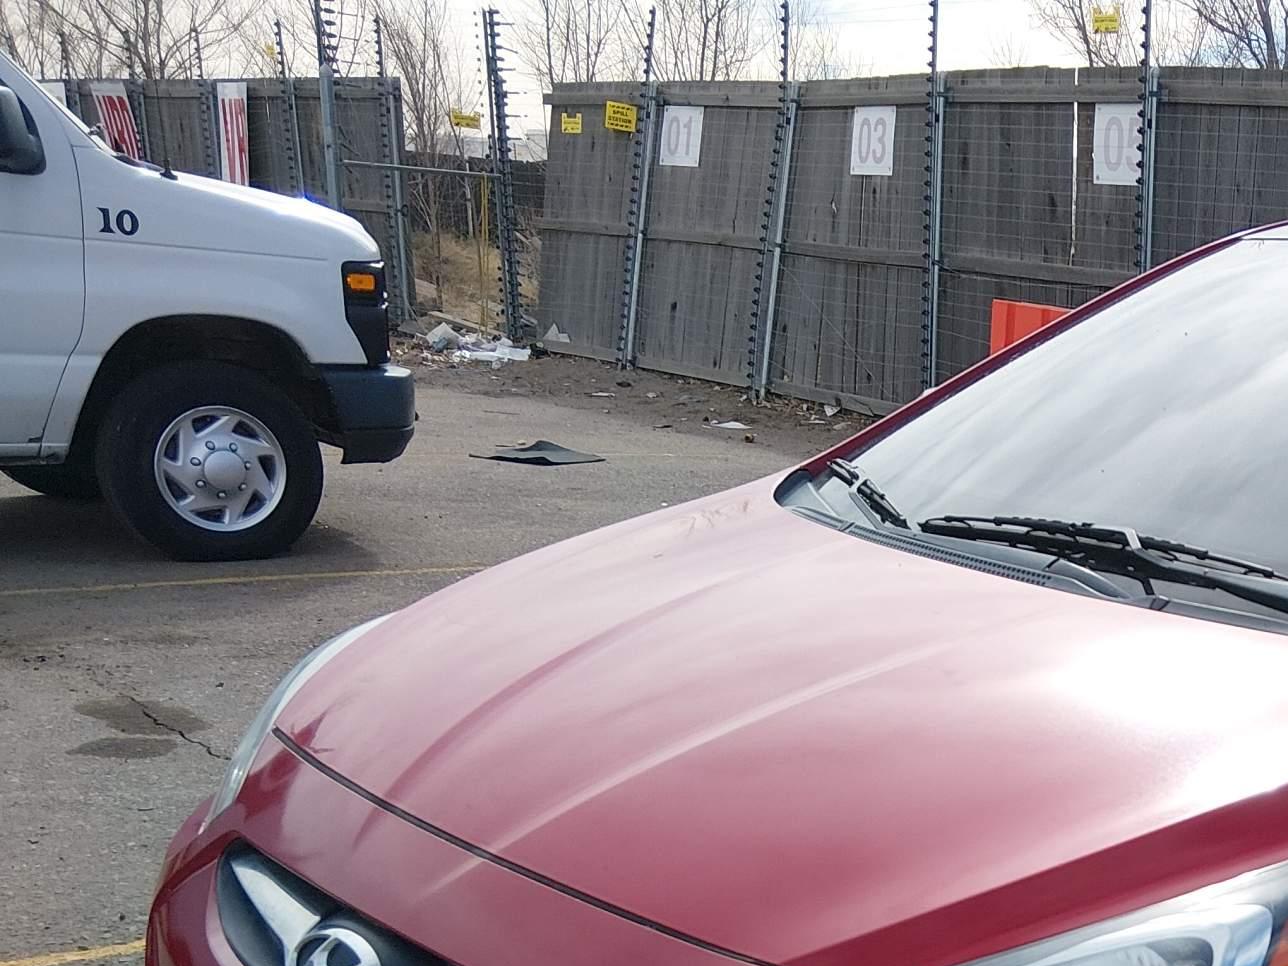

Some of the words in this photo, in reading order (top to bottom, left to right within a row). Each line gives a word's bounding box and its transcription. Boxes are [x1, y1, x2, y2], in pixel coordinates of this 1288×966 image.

[607, 115, 632, 124] STATION
[612, 109, 628, 117] SPILL
[668, 115, 692, 157] 01
[857, 117, 888, 165] 03
[96, 206, 140, 236] 10
